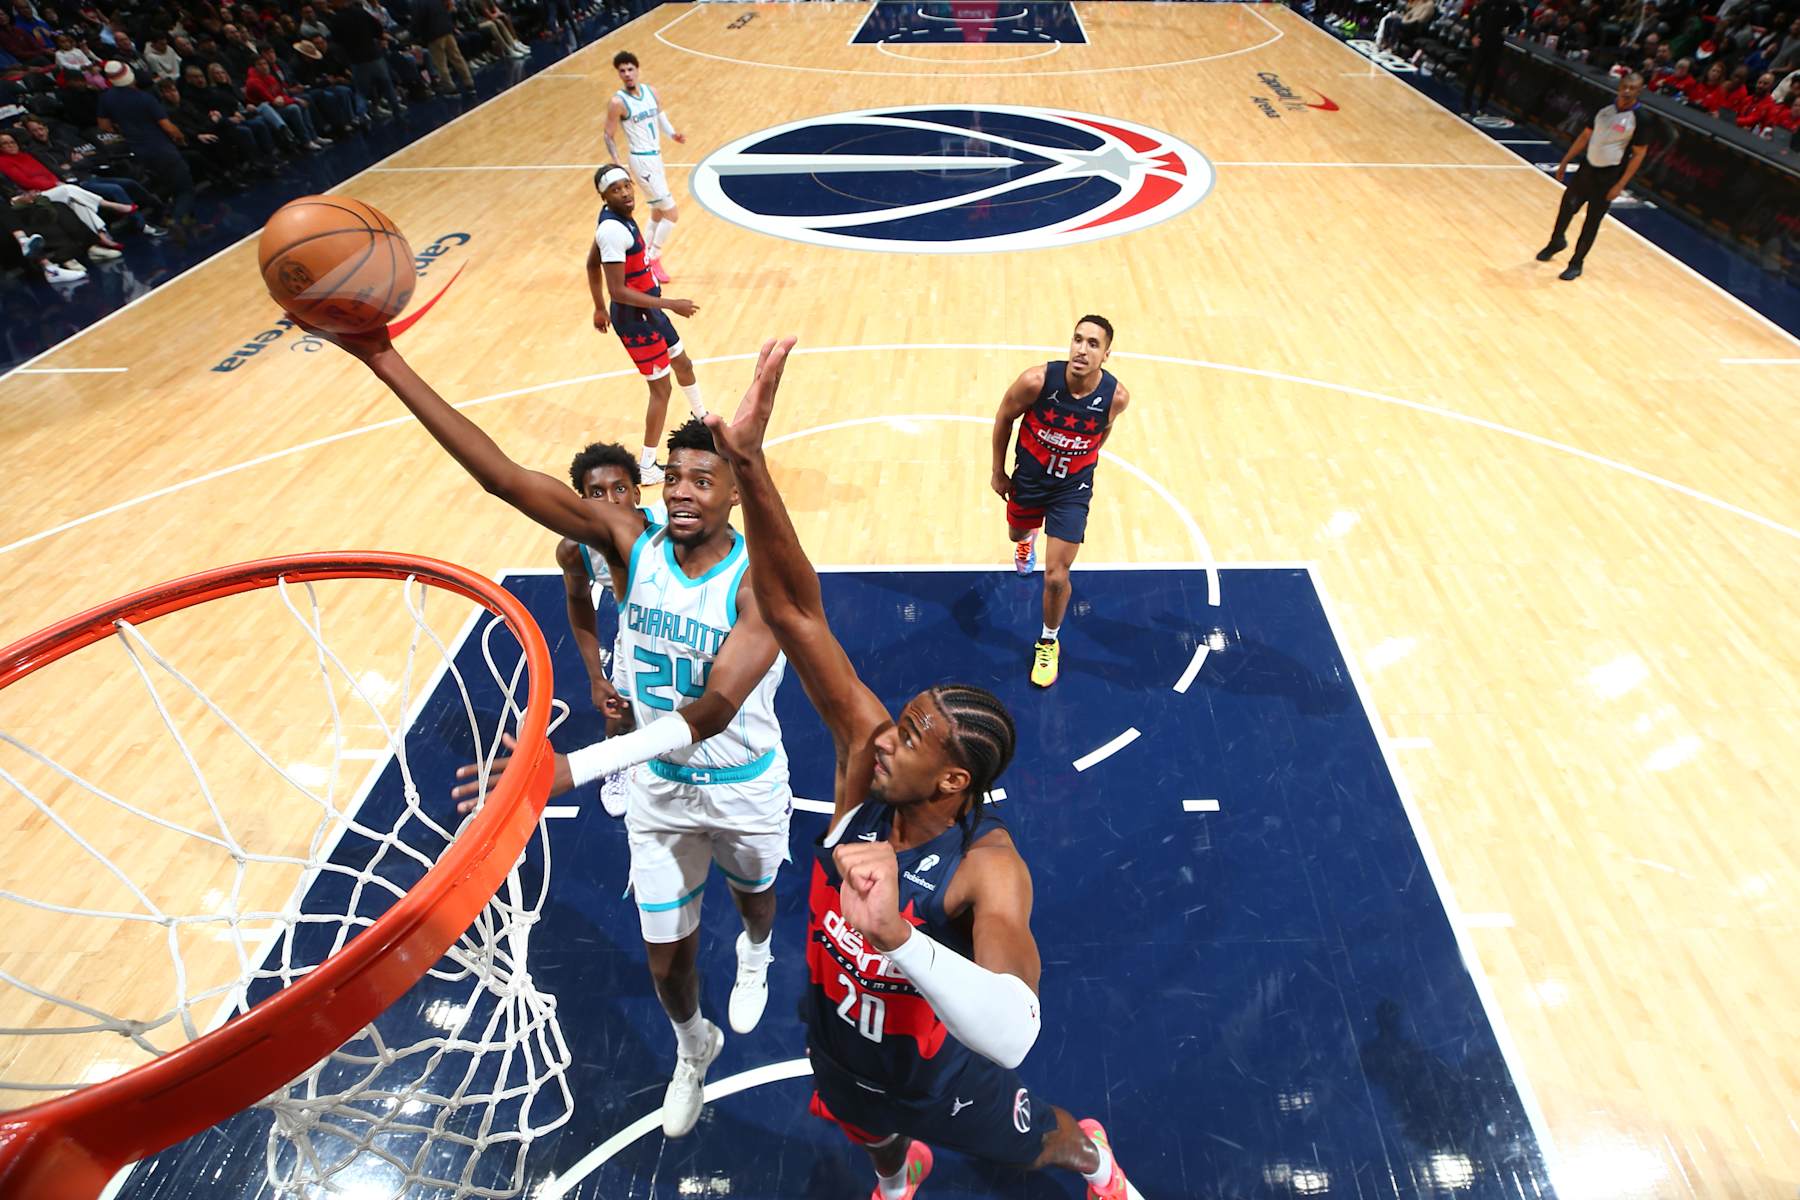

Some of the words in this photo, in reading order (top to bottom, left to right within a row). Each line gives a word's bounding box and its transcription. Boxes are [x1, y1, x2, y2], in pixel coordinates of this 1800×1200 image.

[648, 122, 656, 140] 1
[211, 318, 295, 373] rena
[1046, 454, 1072, 479] 15
[628, 603, 730, 651] CHARLOTT
[634, 645, 714, 712] 24
[837, 973, 886, 1043] 20
